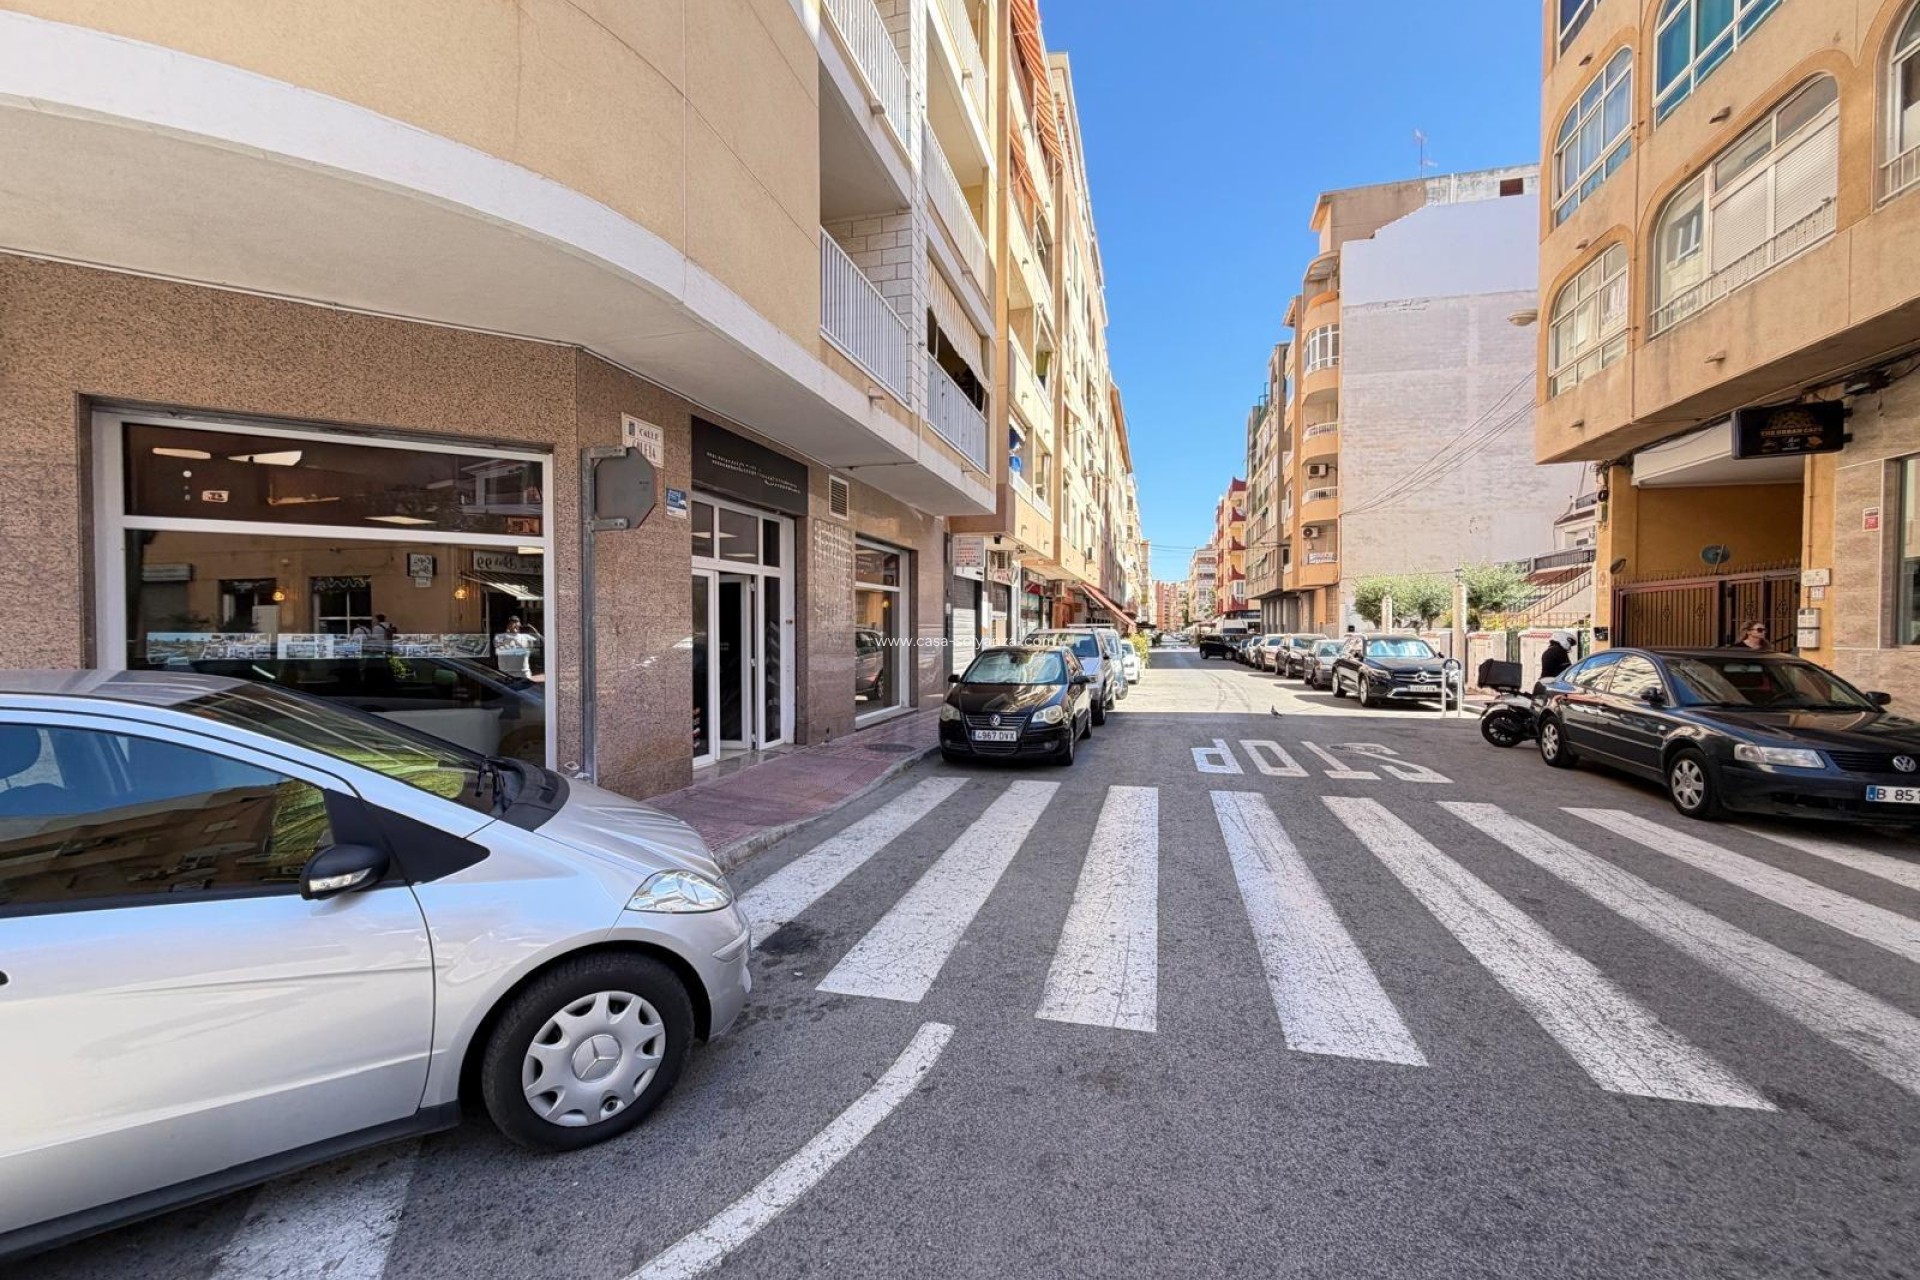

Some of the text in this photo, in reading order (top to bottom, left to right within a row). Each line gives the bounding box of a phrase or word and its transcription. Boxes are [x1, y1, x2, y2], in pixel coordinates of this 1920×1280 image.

[639, 428, 659, 441] CALLE
[1190, 738, 1455, 784] STOP
[1877, 788, 1886, 800] B
